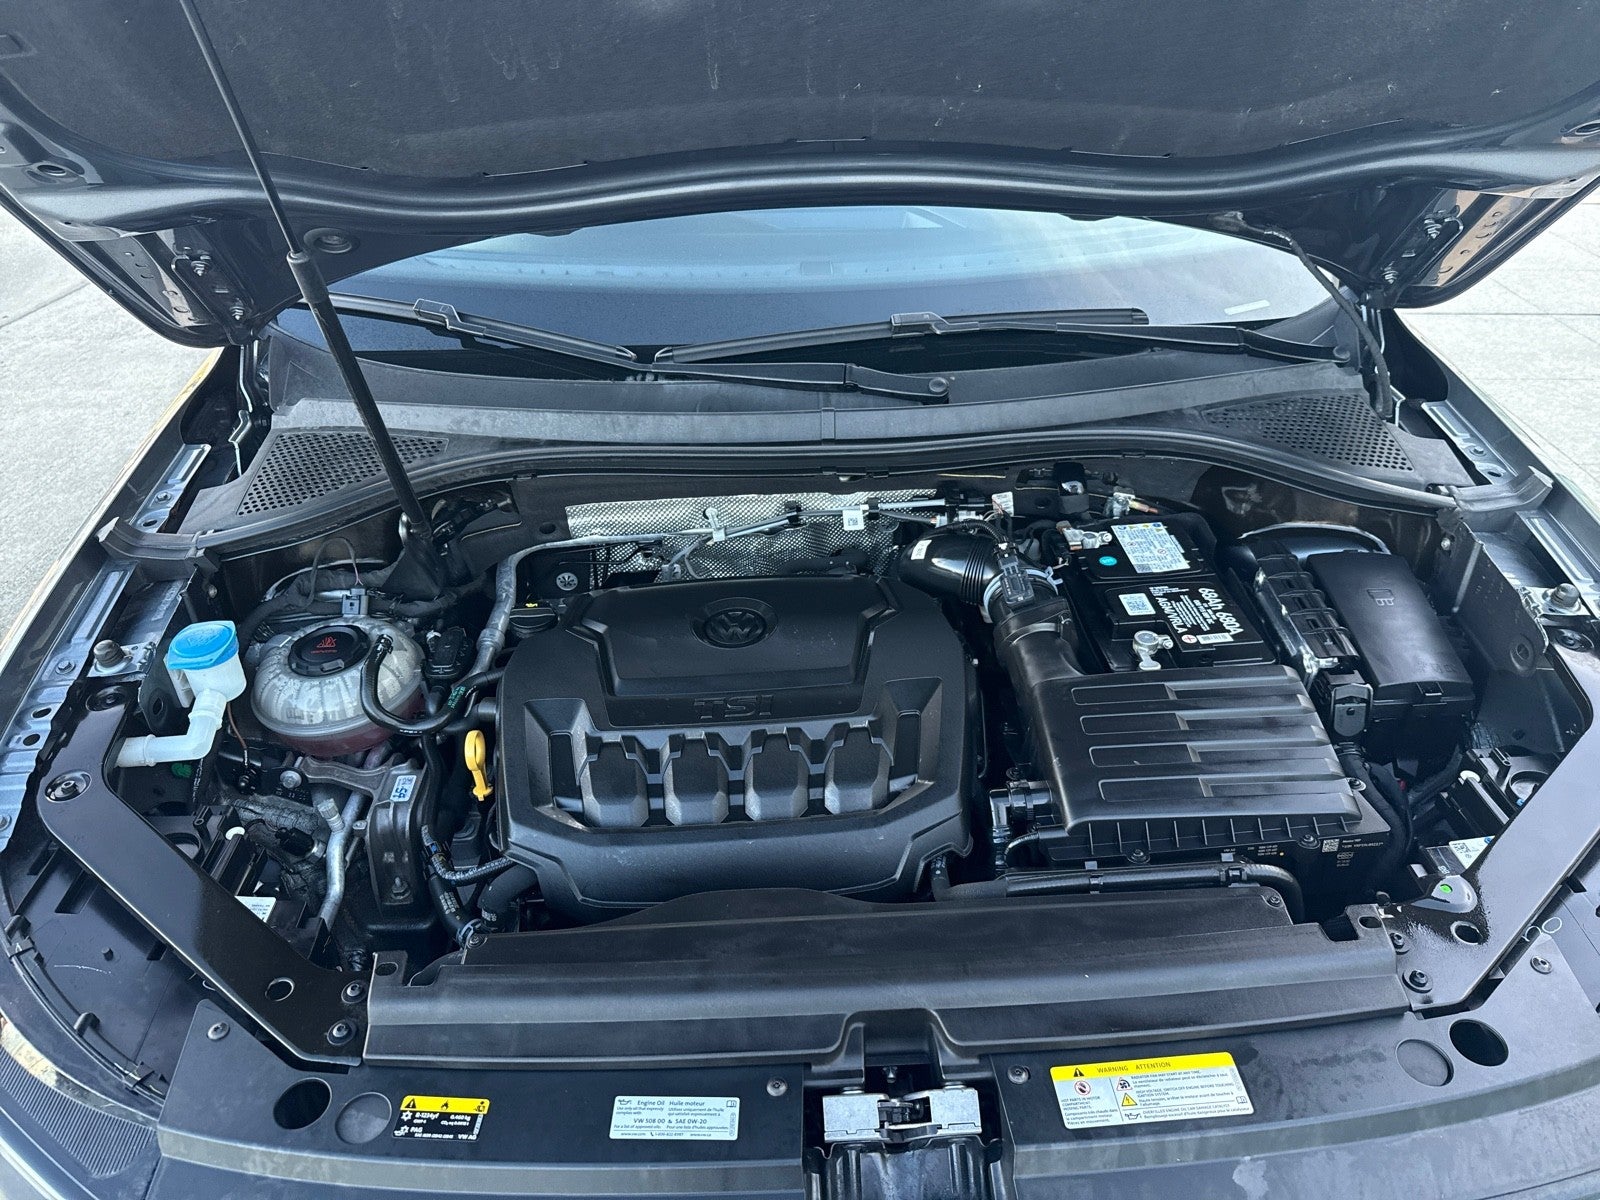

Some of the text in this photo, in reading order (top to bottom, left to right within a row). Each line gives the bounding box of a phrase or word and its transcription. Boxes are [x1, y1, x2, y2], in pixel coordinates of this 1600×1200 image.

[1198, 588, 1225, 610] 68Ah
[1216, 612, 1244, 635] 680A
[694, 694, 774, 720] TSI
